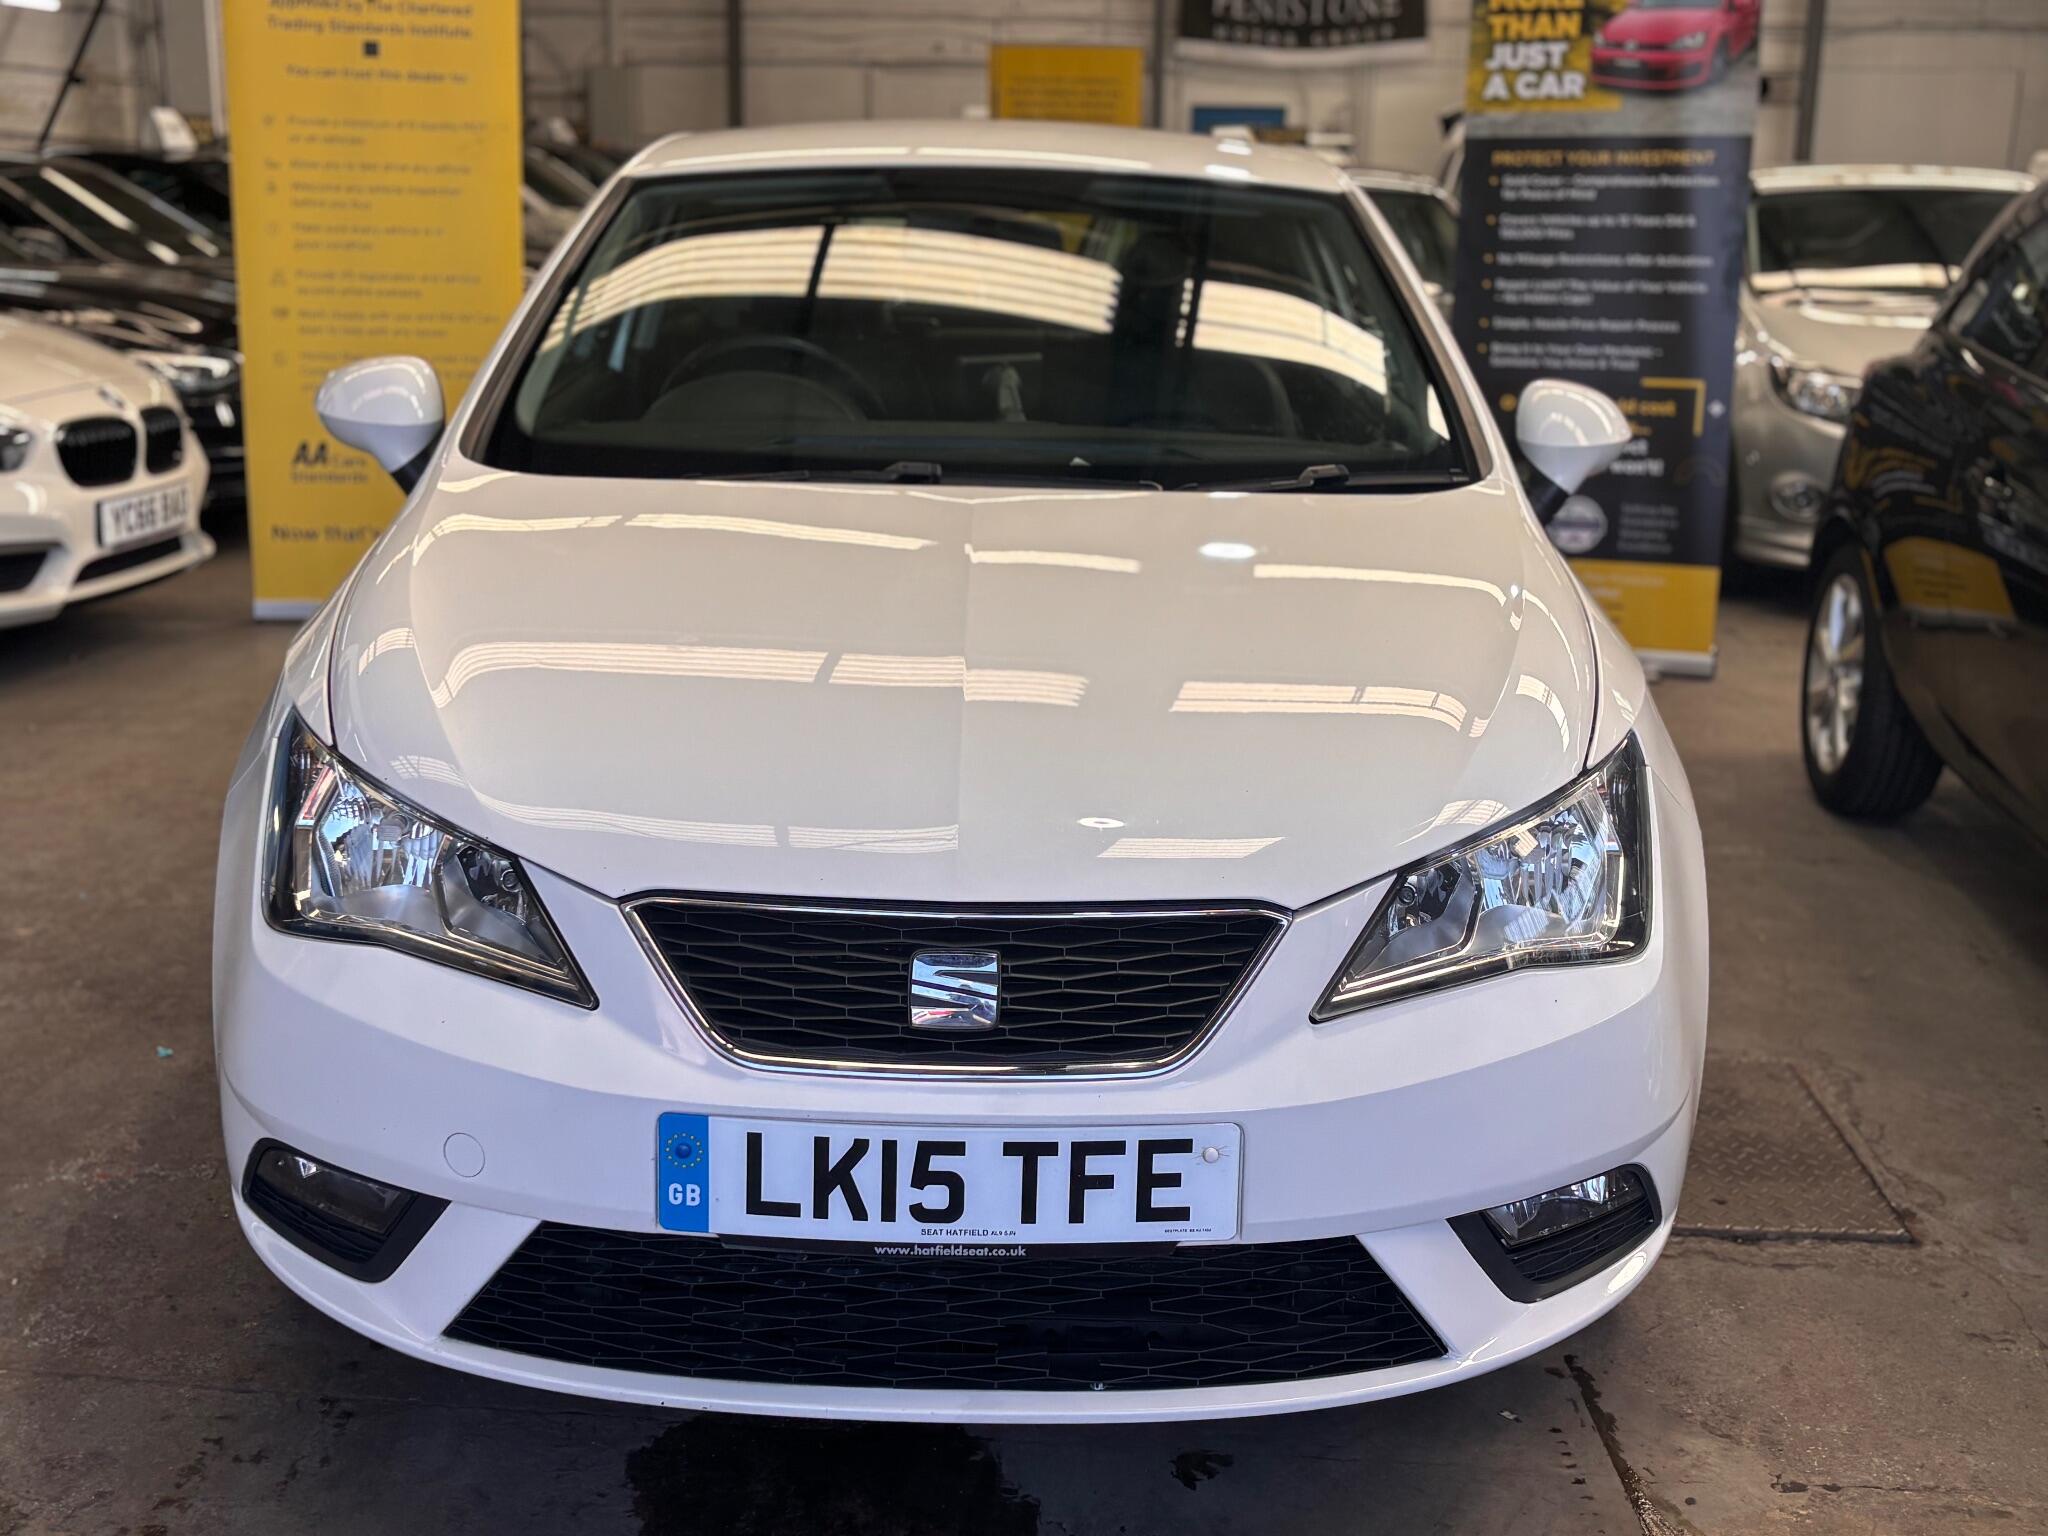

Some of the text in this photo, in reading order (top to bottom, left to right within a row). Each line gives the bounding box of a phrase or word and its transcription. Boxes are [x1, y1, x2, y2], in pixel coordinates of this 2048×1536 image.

[1488, 12, 1583, 40] THAN
[1484, 41, 1569, 71] JUST
[1481, 70, 1586, 101] A CAR
[1491, 150, 1716, 167] PROTECT YOUR INVESTMENT
[293, 441, 327, 465] AA
[271, 523, 318, 540] Now
[745, 1131, 1194, 1224] LK15 TFE
[667, 1183, 701, 1206] GB
[921, 1228, 944, 1236] SEAT
[946, 1228, 988, 1237] HATFIELD
[875, 1243, 1027, 1258] www.hatfieldseat.co.uk
